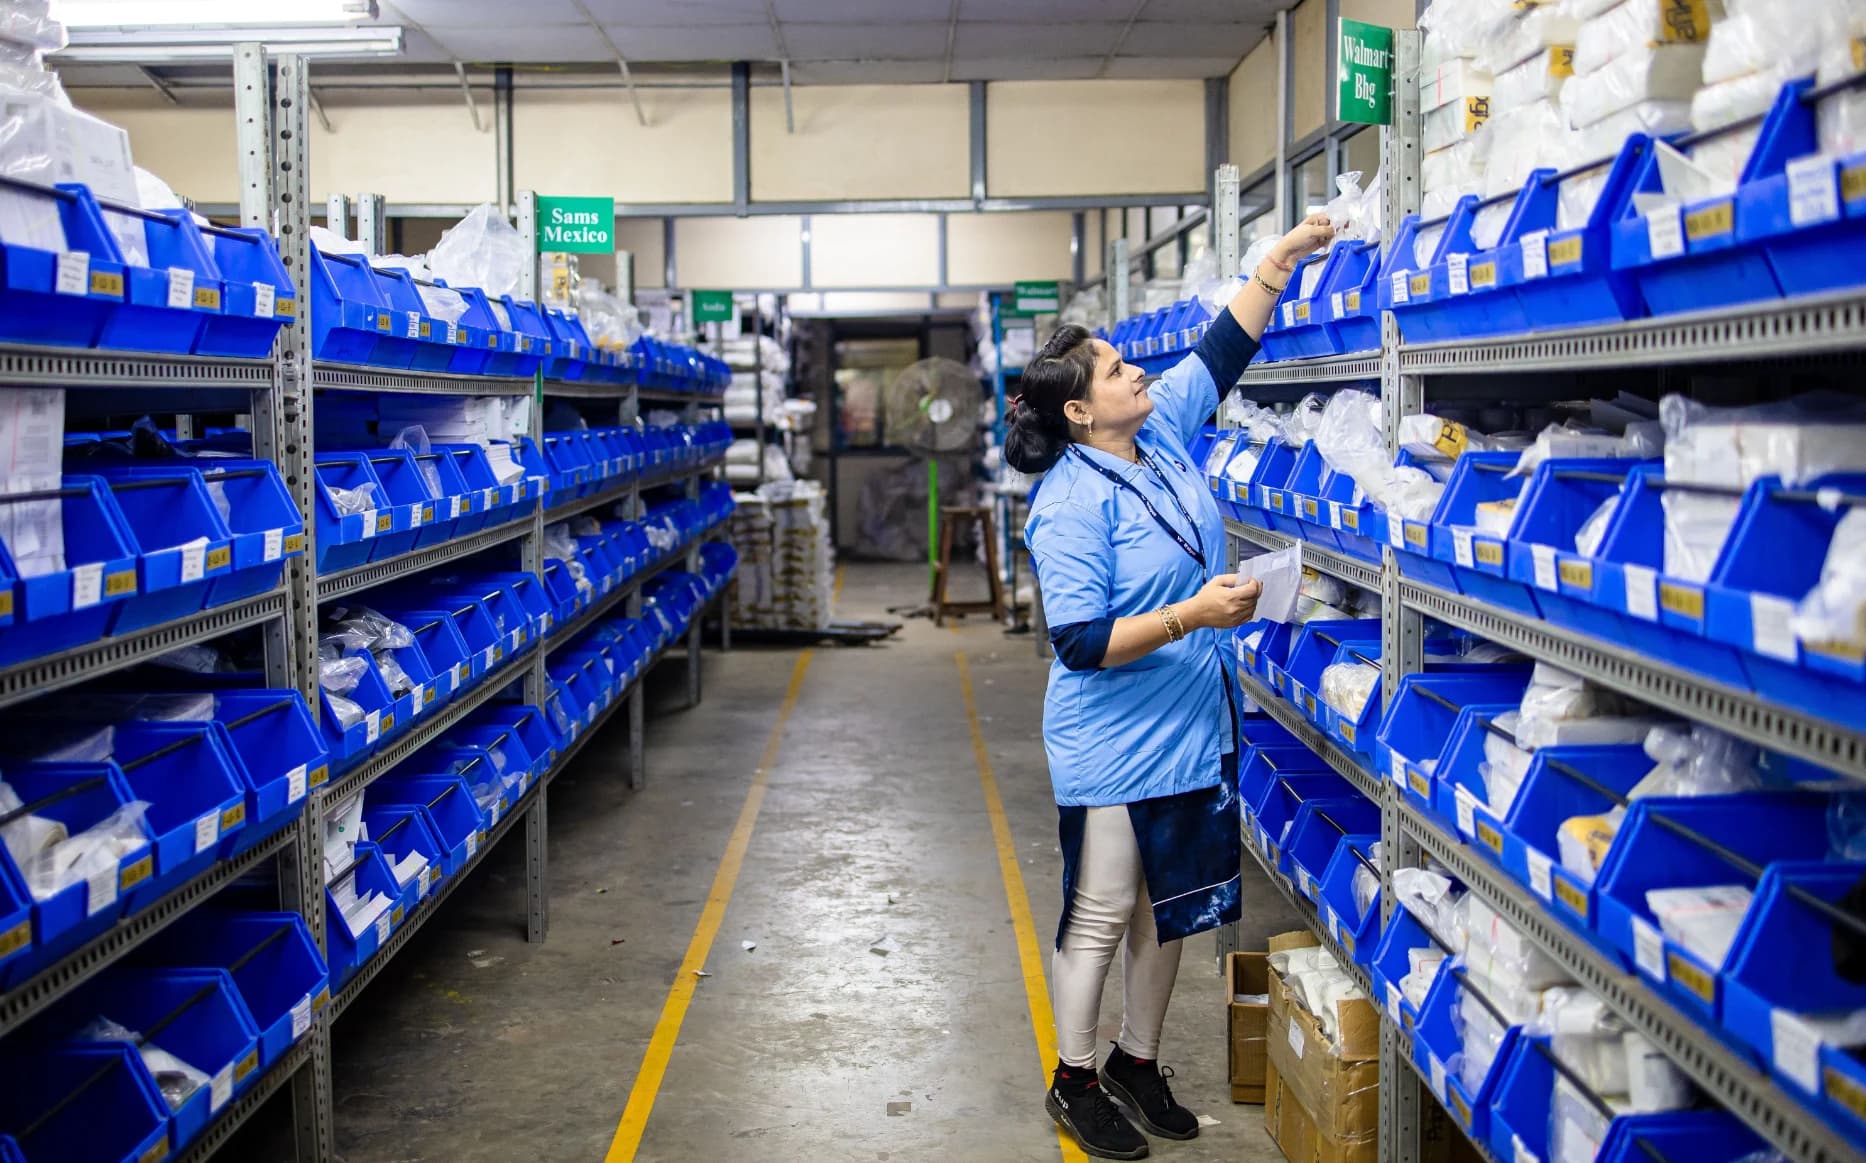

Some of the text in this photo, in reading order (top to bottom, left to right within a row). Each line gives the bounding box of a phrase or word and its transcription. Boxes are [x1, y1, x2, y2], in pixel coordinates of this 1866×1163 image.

[1343, 35, 1389, 70] Walmart
[1354, 72, 1377, 109] Bhg
[551, 207, 599, 225] Sams
[544, 226, 608, 243] Mexico
